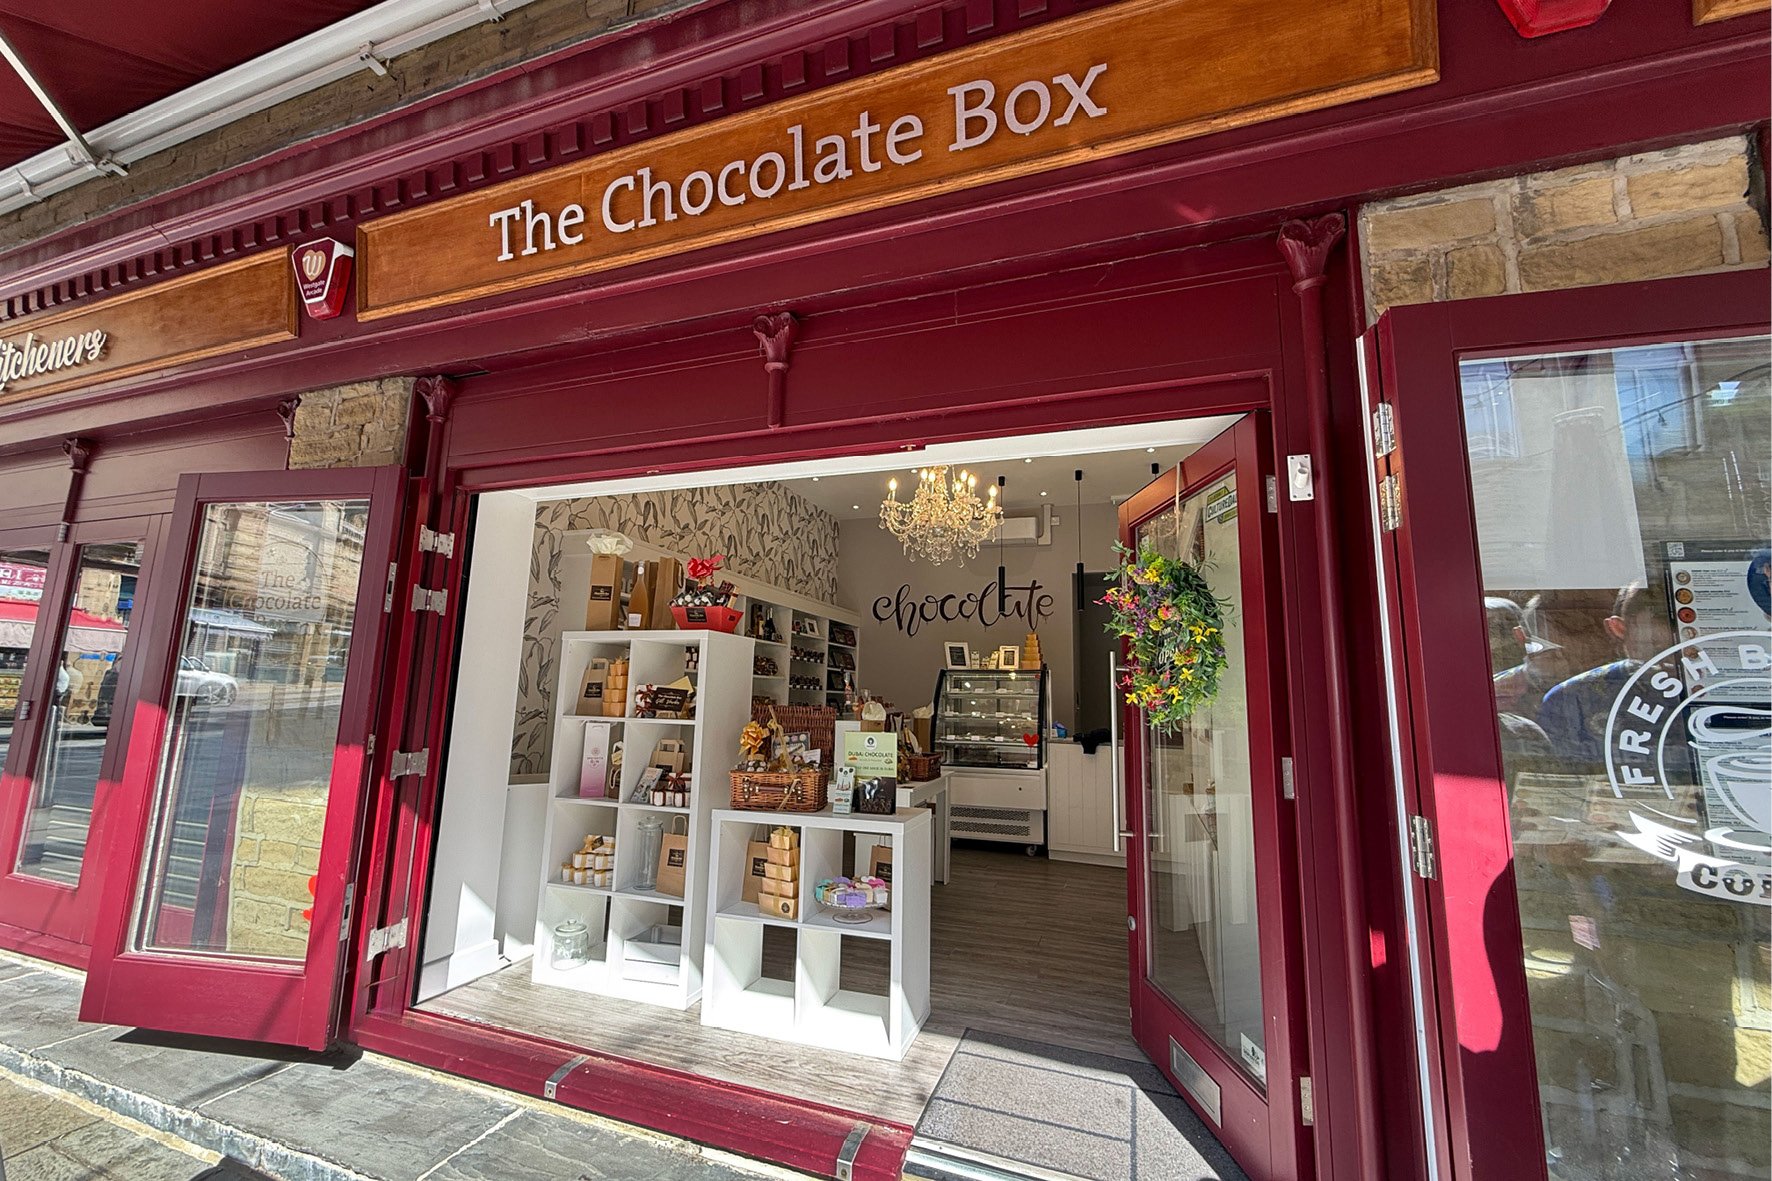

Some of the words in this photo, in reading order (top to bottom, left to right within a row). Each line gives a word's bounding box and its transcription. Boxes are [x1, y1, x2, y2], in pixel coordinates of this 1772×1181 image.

[489, 199, 585, 262] The
[602, 110, 924, 233] Chocolate
[947, 63, 1108, 152] Box
[305, 288, 323, 296] Arcade
[0, 329, 107, 391] itcheners
[261, 571, 296, 588] The
[1619, 649, 1720, 785] FRESH
[1738, 643, 1772, 670] B
